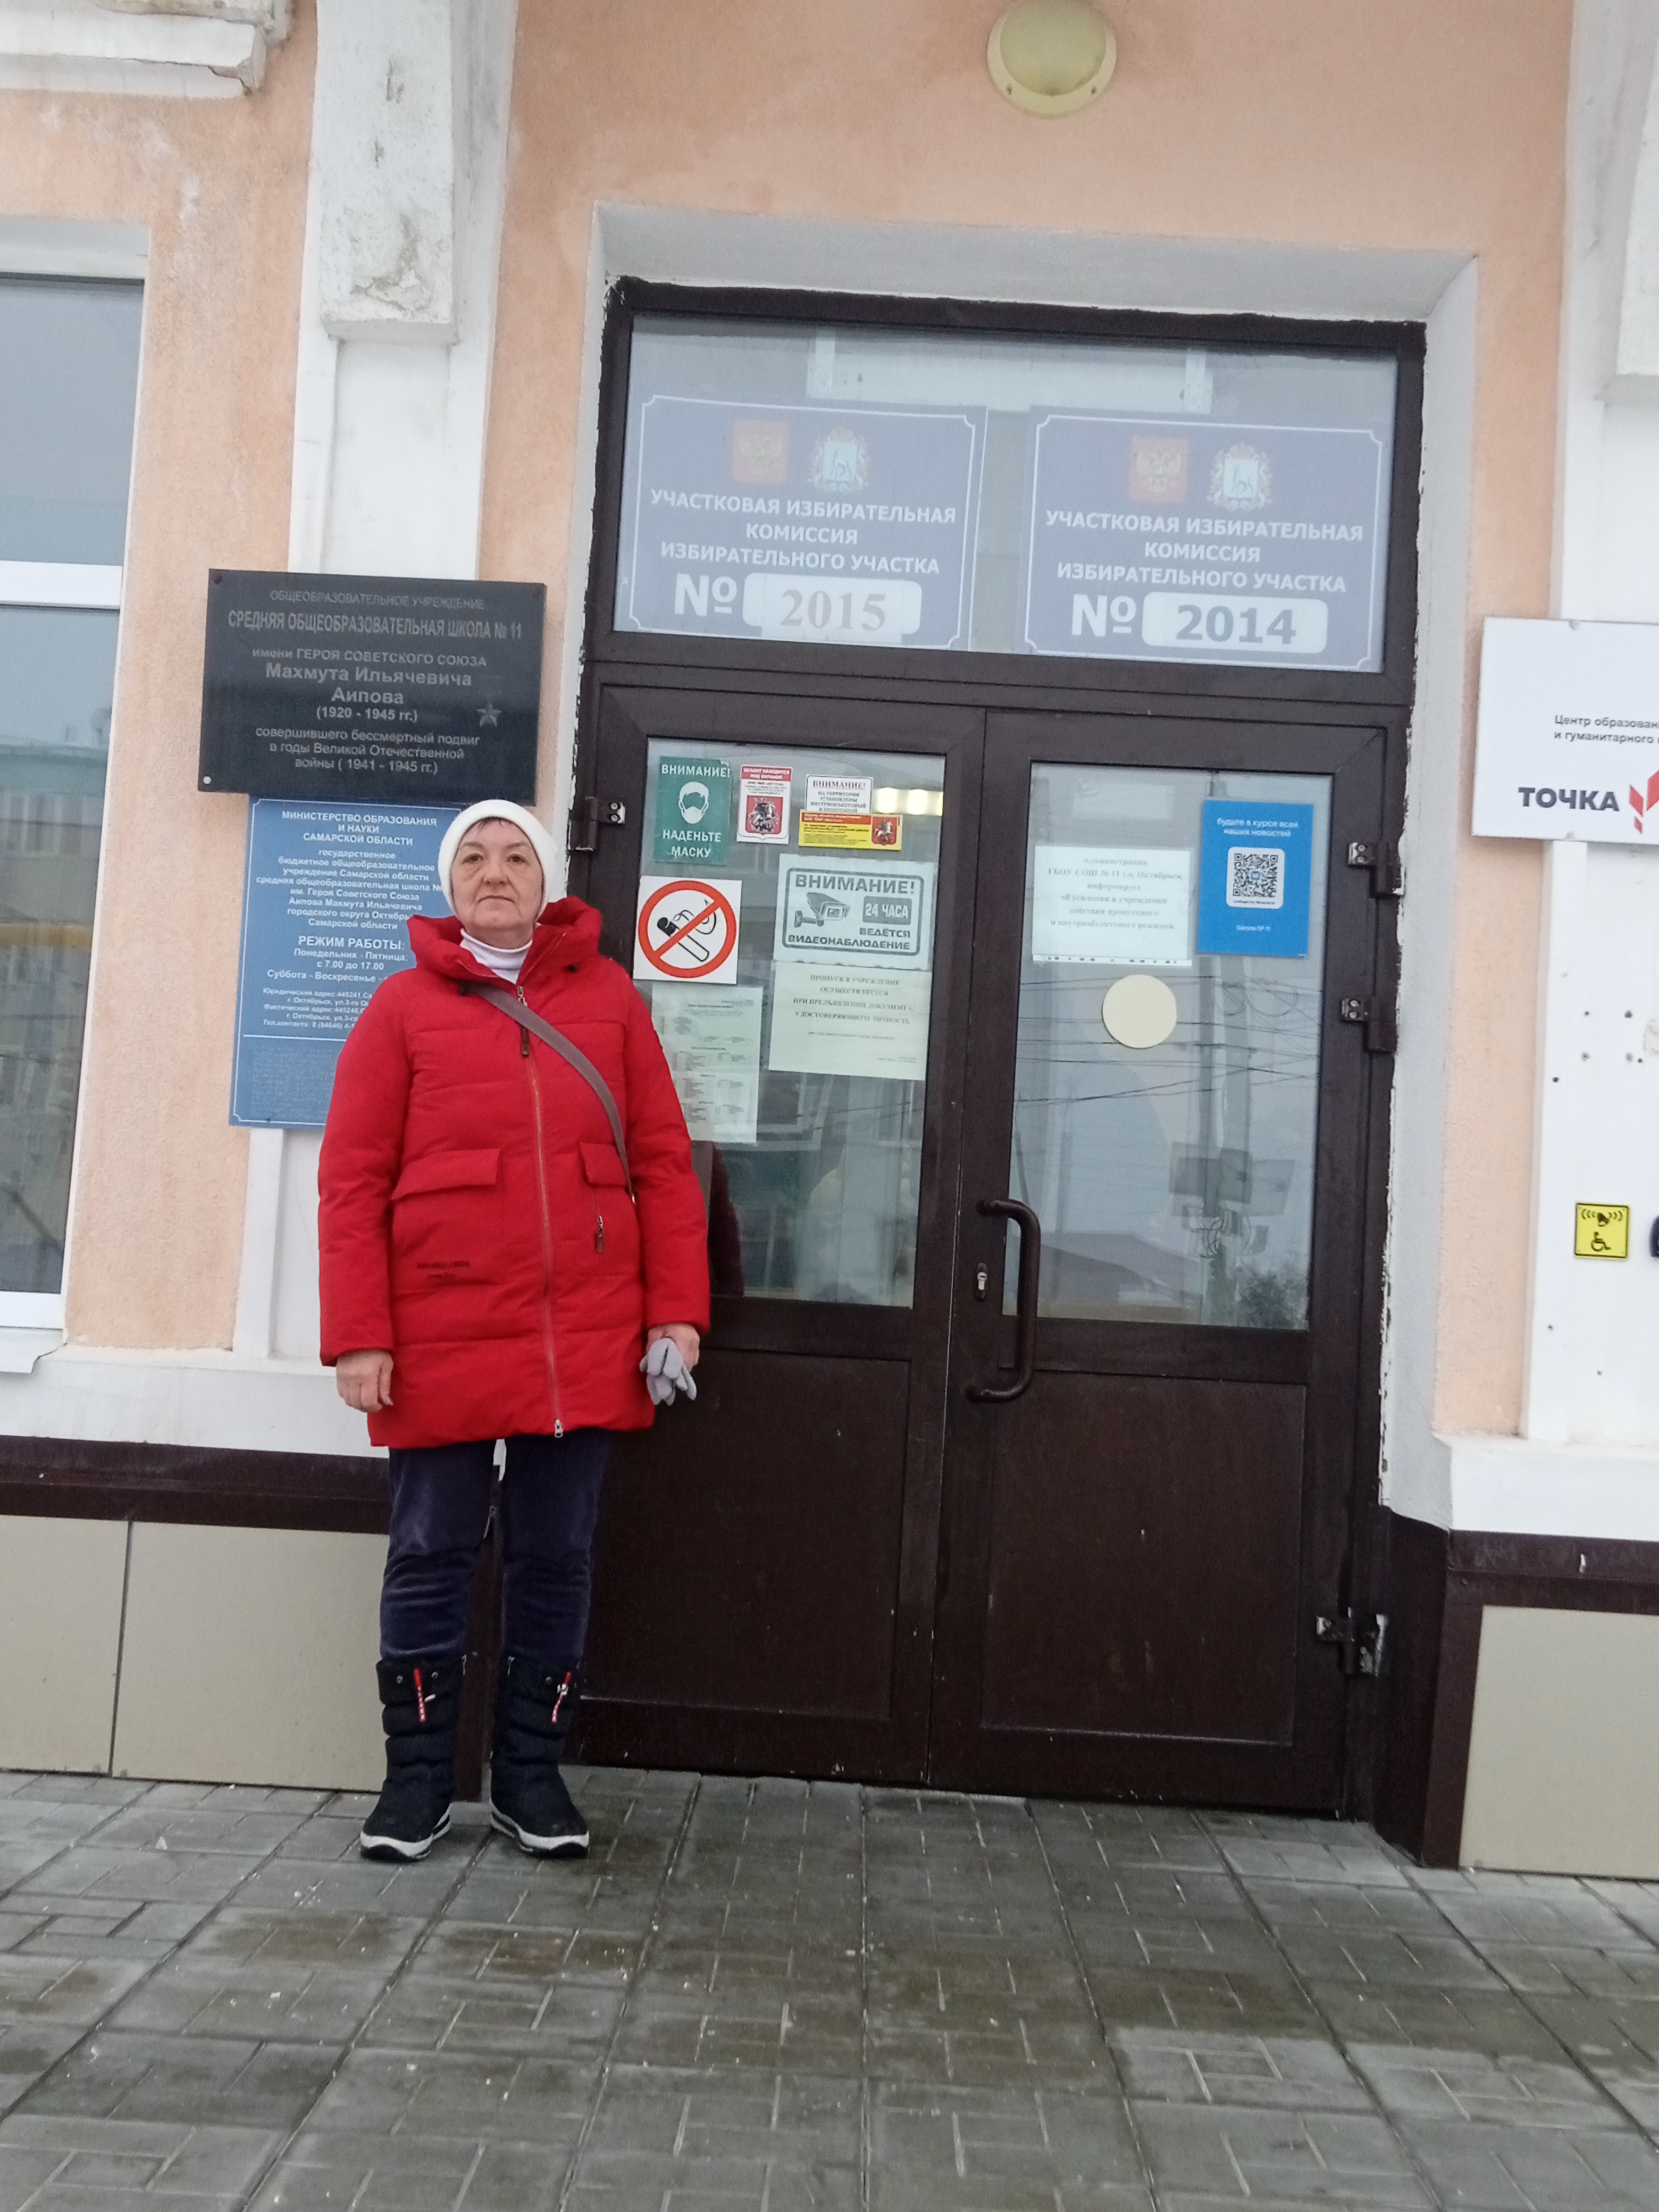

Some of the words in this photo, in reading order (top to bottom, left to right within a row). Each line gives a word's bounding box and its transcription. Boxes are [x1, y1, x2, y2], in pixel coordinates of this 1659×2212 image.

[651, 489, 780, 515] УЧАСТКОВАЯ
[787, 500, 956, 524] ИЗБИРАТЕЛЬНАЯ
[1046, 510, 1179, 532] УЧАСТКОВАЯ
[1186, 518, 1363, 541] ИЗБИРАТЕЛЬНАЯ
[746, 523, 858, 545] КОМИССИЯ
[661, 542, 844, 569] ИЗБИРАТЕЛЬНОГО
[851, 555, 940, 574] УЧАСТКА
[1144, 542, 1261, 563] КОМИССИЯ
[1057, 563, 1247, 589] ИЗБИРАТЕЛЬНОГО
[1253, 573, 1346, 593] УЧАСТКА
[270, 590, 409, 607] ОБЩЕОБРАЗОВАТЕЛЬНОЕ
[412, 596, 485, 610] УЧРЕЖДЕНИЕ
[674, 573, 737, 617] №
[780, 589, 886, 631] 2015
[228, 609, 285, 631] СРЕДНЯЯ
[288, 613, 445, 636] ОБЩЕОБРАЗОВАТЕЛЬНАЯ
[448, 620, 491, 638] ШКОЛА
[494, 622, 507, 638] №
[510, 622, 522, 639] 11
[1071, 594, 1136, 637] №
[1175, 605, 1296, 644] 2014
[252, 648, 293, 658] имени
[296, 648, 340, 661] ГЕРОЯ
[343, 650, 434, 665] СОВЕТСКОГО
[437, 655, 487, 667] СОЮЗА
[266, 663, 349, 684] Махмута
[355, 666, 472, 686] Ильячевича
[331, 687, 404, 705] Аипова
[316, 706, 352, 721] (1920
[365, 708, 396, 720] 1945
[398, 709, 418, 724] гг.)
[1554, 714, 1591, 728] Центр
[1594, 716, 1659, 730] образован
[255, 728, 348, 740] совершившего
[351, 729, 434, 744] бессмертный
[438, 735, 481, 745] подвиг
[1554, 731, 1562, 740] и
[1564, 732, 1654, 745] гуманитарного
[280, 743, 311, 755] годы
[313, 742, 366, 755] Великой
[370, 744, 465, 759] Отечественной
[295, 757, 334, 769] войны
[346, 758, 375, 770] 1941
[389, 760, 418, 772] 1945
[421, 761, 438, 775] гг.)
[661, 764, 731, 778] ВНИМАНИЕ!
[812, 780, 866, 789] ВНИМАНИЕ!
[1518, 787, 1620, 812] ТОЧКА
[282, 810, 361, 823] МИНИСТЕРСТВО
[364, 815, 437, 826] ОБРАЗОВАНИЯ
[1217, 817, 1245, 827] будьте
[1253, 820, 1278, 829] курсе
[348, 825, 380, 834] НАУКИ
[662, 829, 722, 843] НАДЕНЬТЕ
[1251, 829, 1291, 837] новостей
[303, 832, 364, 843] САМАРСКОЙ
[366, 836, 413, 846] ОБЛАСТИ
[319, 849, 396, 860] государственное
[671, 846, 711, 858] МАСКУ
[278, 856, 329, 867] бюджетное
[331, 859, 435, 872] общеобразовательное
[339, 870, 390, 879] Самарской
[392, 871, 430, 882] области
[1137, 870, 1182, 880] Октябрьск
[256, 877, 294, 886] средняя
[296, 878, 399, 890] общеобразовательная
[795, 874, 915, 895] ВНИМАНИЕ!
[307, 887, 334, 898] Героя
[336, 889, 388, 900] Советского
[390, 891, 420, 901] Союза
[1071, 894, 1110, 903] усилении
[288, 897, 323, 907] Аипова
[325, 899, 365, 910] Махмута
[367, 901, 422, 911] Ильячевича
[864, 903, 879, 917] 24
[881, 904, 909, 919] ЧАСА
[287, 908, 337, 918] городского
[339, 910, 370, 920] округа
[372, 911, 409, 922] Октябрь
[308, 918, 358, 928] Самарской
[360, 920, 398, 931] области
[859, 926, 911, 939] ВЕДЁТСЯ
[298, 935, 345, 948] РЕЖИМ
[347, 938, 405, 950] РАБОТЫ:
[787, 934, 910, 950] ВИДЕОНАБЛЮДЕНИЕ
[294, 948, 357, 959] Понедельник
[325, 960, 343, 969] 7.00
[361, 961, 384, 971] 17.00
[266, 969, 307, 980] Суббота
[315, 971, 376, 983] Воскресенье
[810, 974, 844, 983] ПРОПУСК
[851, 977, 900, 986] УЧРЕЖДЕНИЕ
[820, 986, 889, 996] ОСУЩЕСТВЛЯЕТСЯ
[809, 999, 866, 1008] ПРЕДЪЯВЛЕНИИ
[795, 1011, 870, 1021] УДОСТОВЕРЯЮЩЕГО
